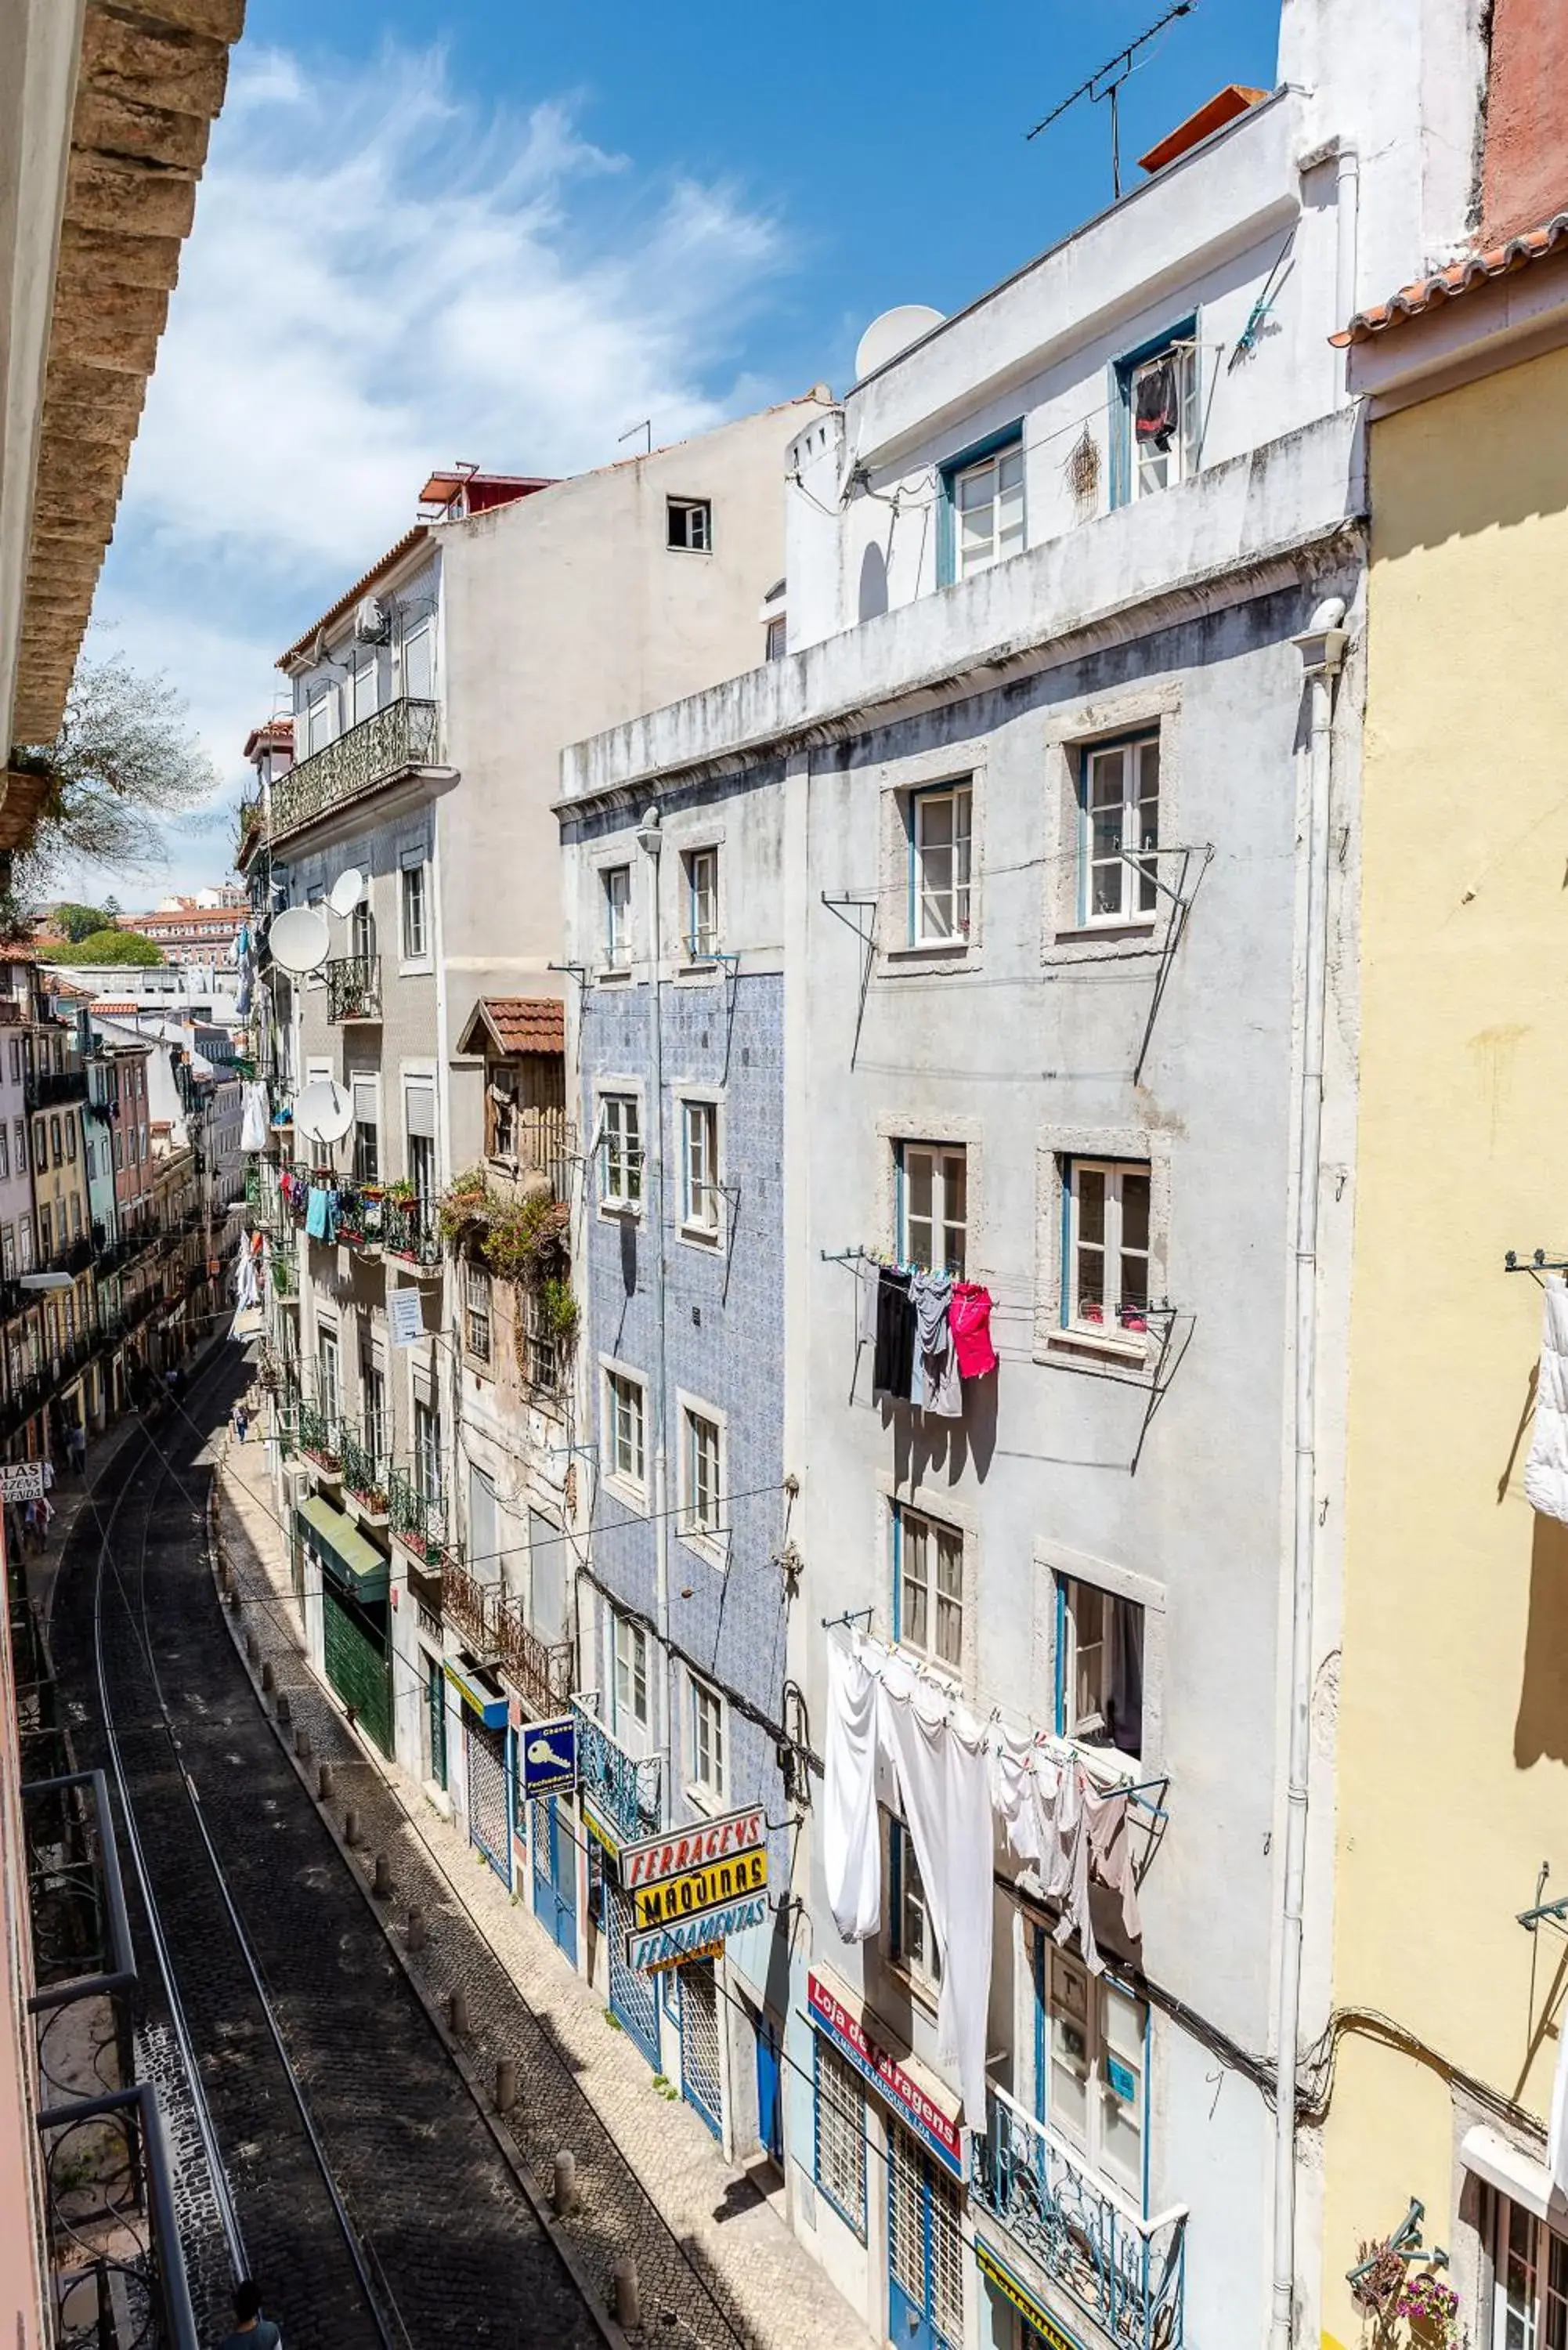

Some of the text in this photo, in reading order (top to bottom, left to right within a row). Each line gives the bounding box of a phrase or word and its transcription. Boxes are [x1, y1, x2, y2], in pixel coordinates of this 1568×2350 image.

[630, 1816, 761, 1885] FERRAGENS
[635, 1898, 766, 1971] FERRAMENTAS
[815, 1981, 846, 2028] Loja
[849, 2018, 869, 2052] de
